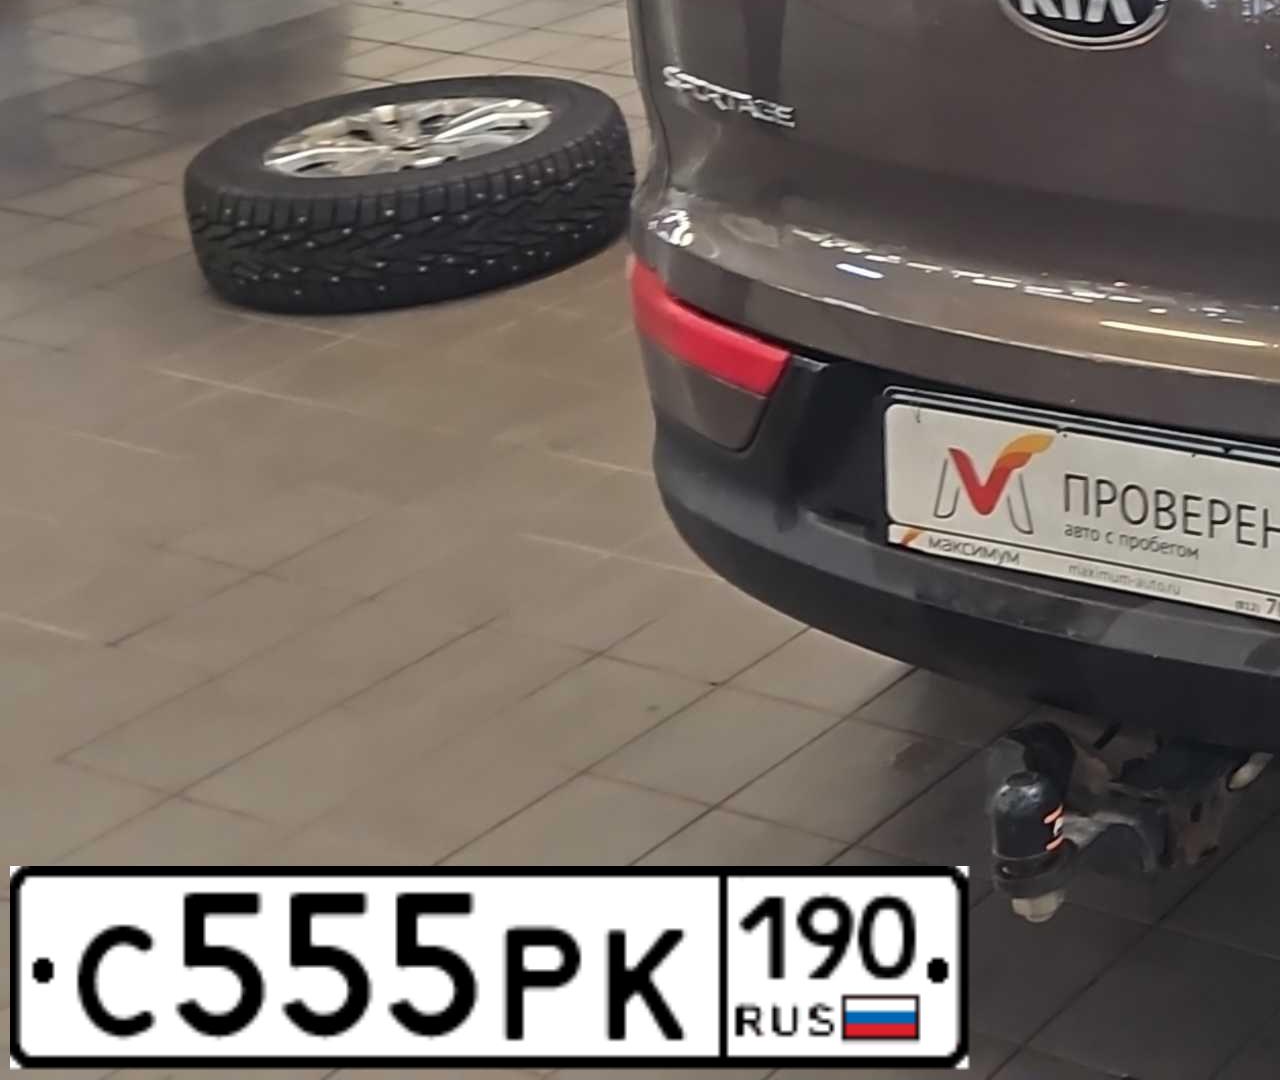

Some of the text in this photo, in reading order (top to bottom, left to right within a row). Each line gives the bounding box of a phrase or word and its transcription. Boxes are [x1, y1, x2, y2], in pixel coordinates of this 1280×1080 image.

[928, 536, 1021, 565] максимум
[1064, 523, 1200, 561] авто с пробегом
